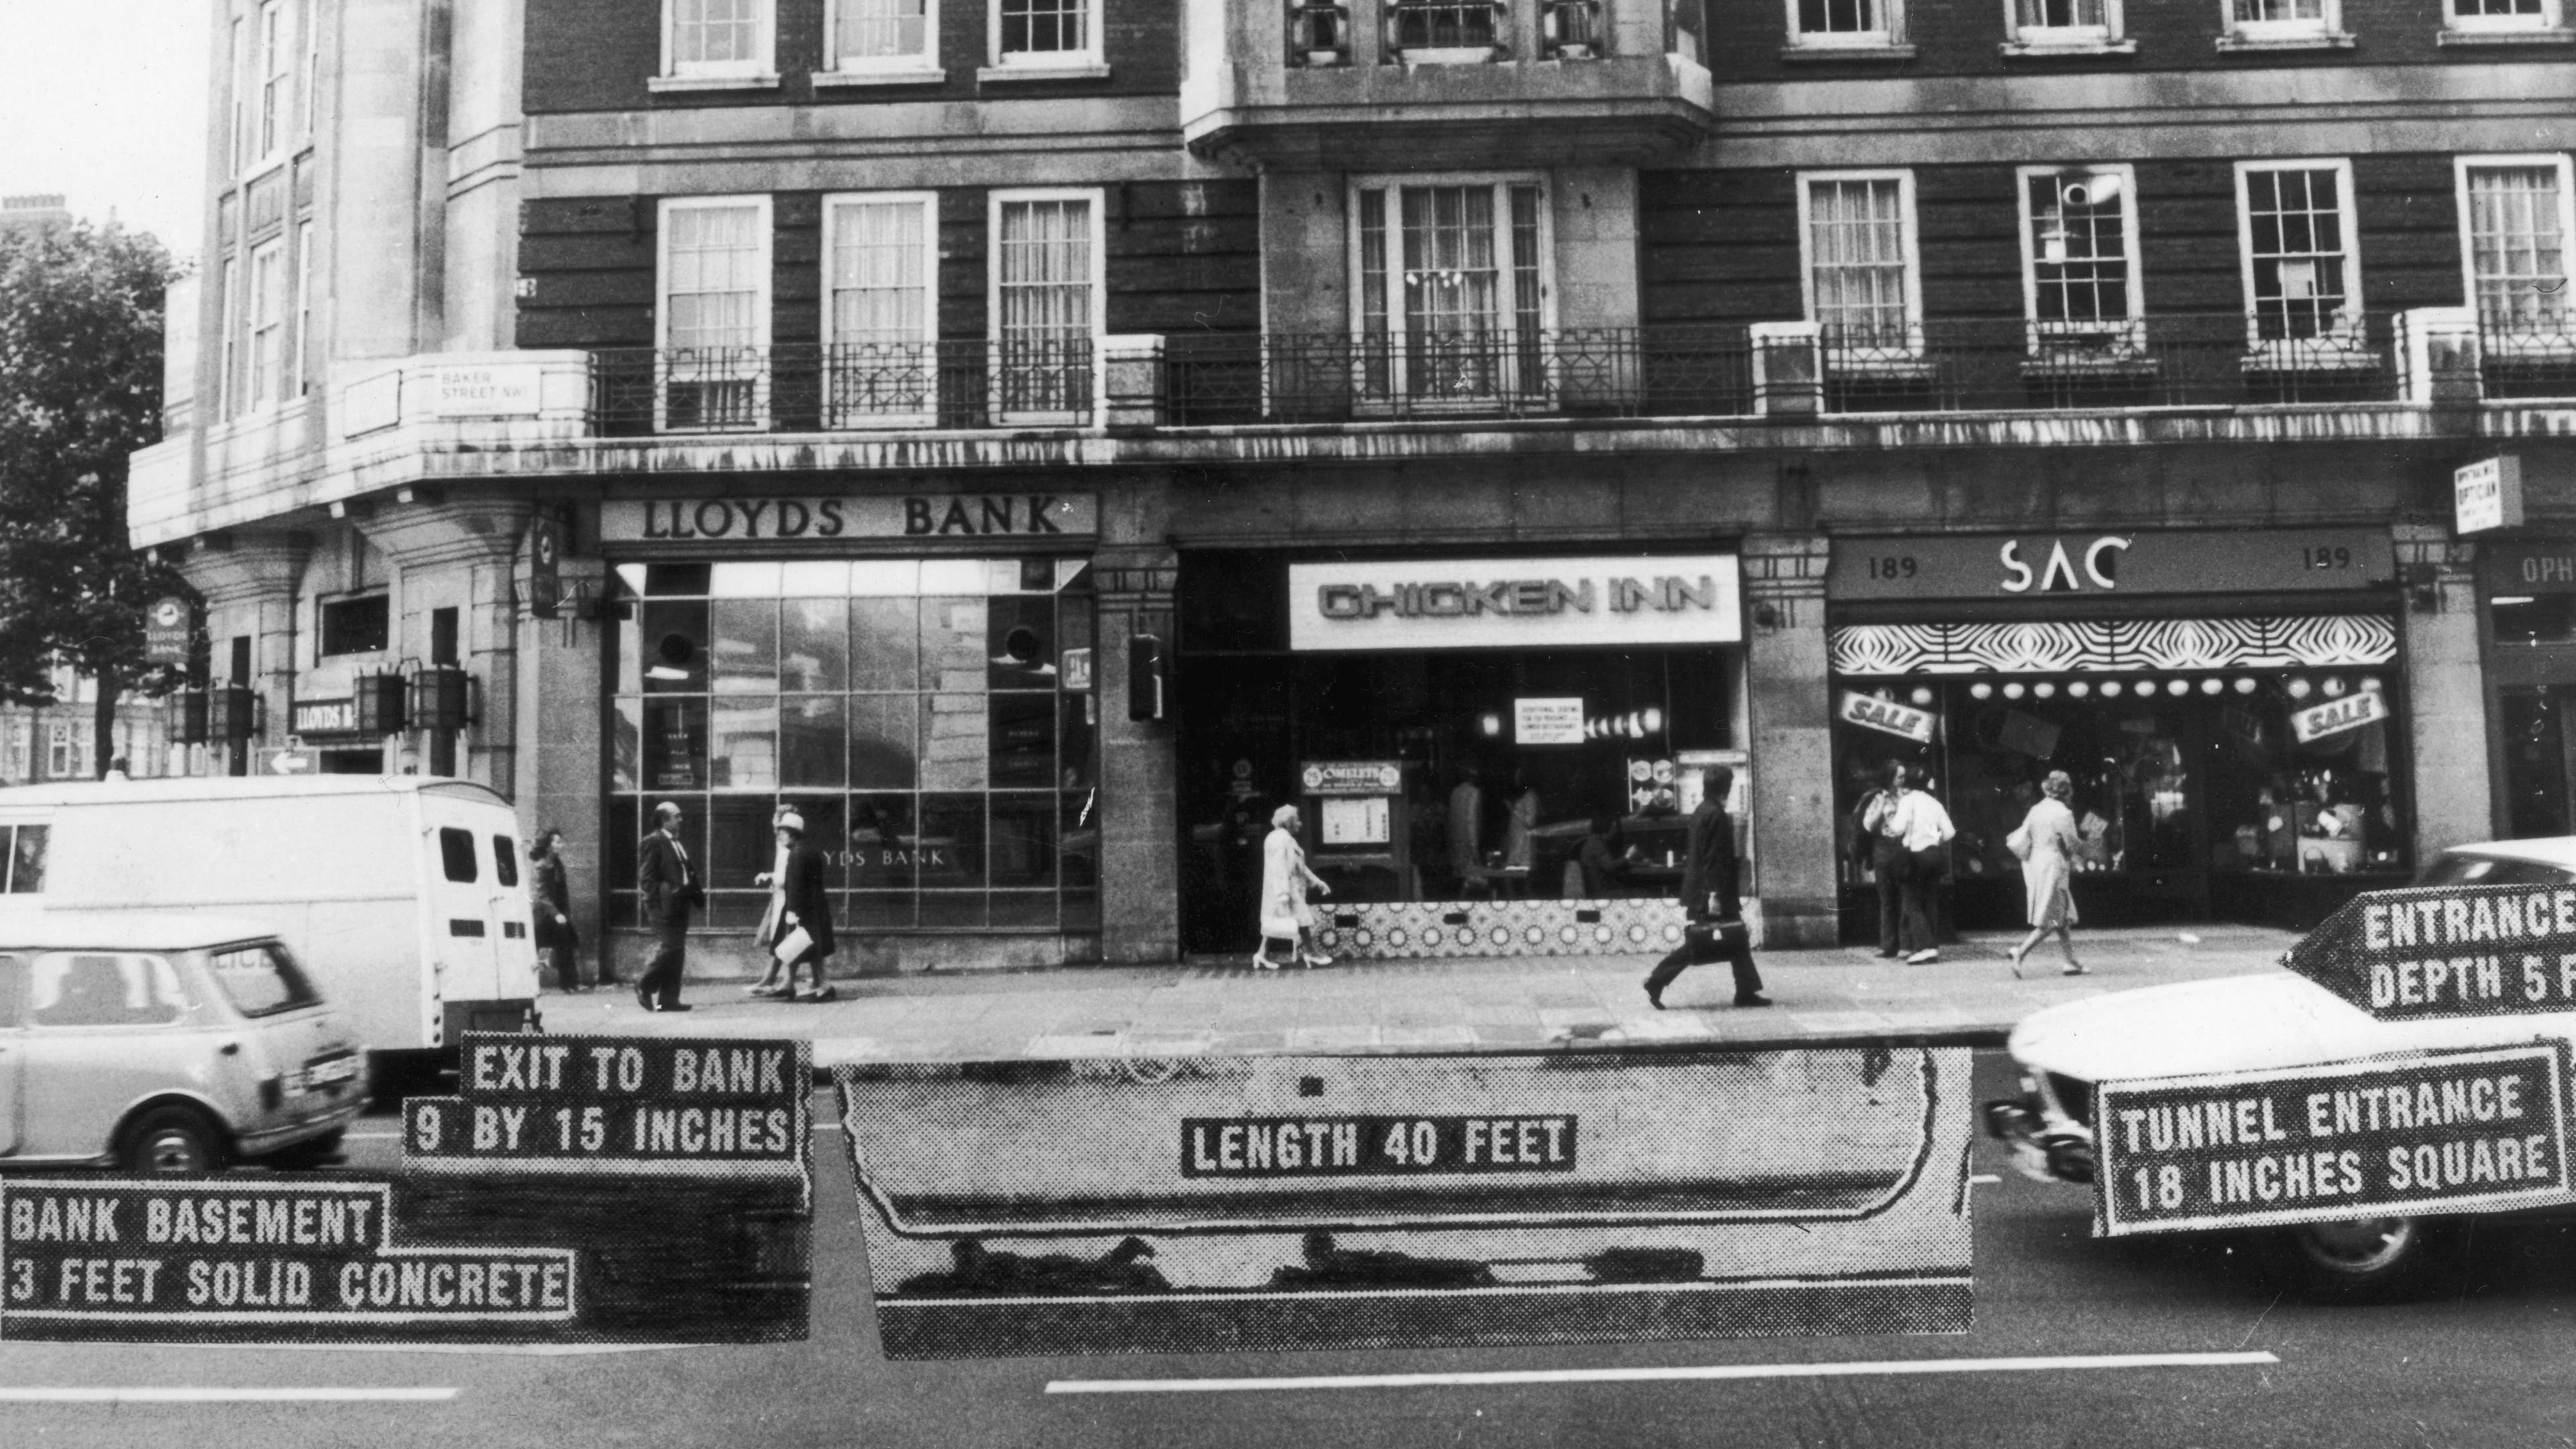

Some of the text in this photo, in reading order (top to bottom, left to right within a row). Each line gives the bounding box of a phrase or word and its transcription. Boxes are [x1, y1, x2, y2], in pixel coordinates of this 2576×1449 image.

[441, 371, 492, 384] BAKER
[441, 386, 496, 399] STREET
[643, 495, 1061, 538] LLOYDS BANK
[1869, 556, 1917, 580] 189
[2000, 536, 2129, 592] SAC
[2304, 547, 2351, 570] 189
[1318, 575, 1716, 620] CHICKEN INN
[147, 631, 188, 641] LLOYDS
[297, 705, 341, 731] LLOYDS
[1848, 699, 1922, 734] SALE
[2307, 696, 2371, 735] SALE
[882, 849, 945, 866] BANK
